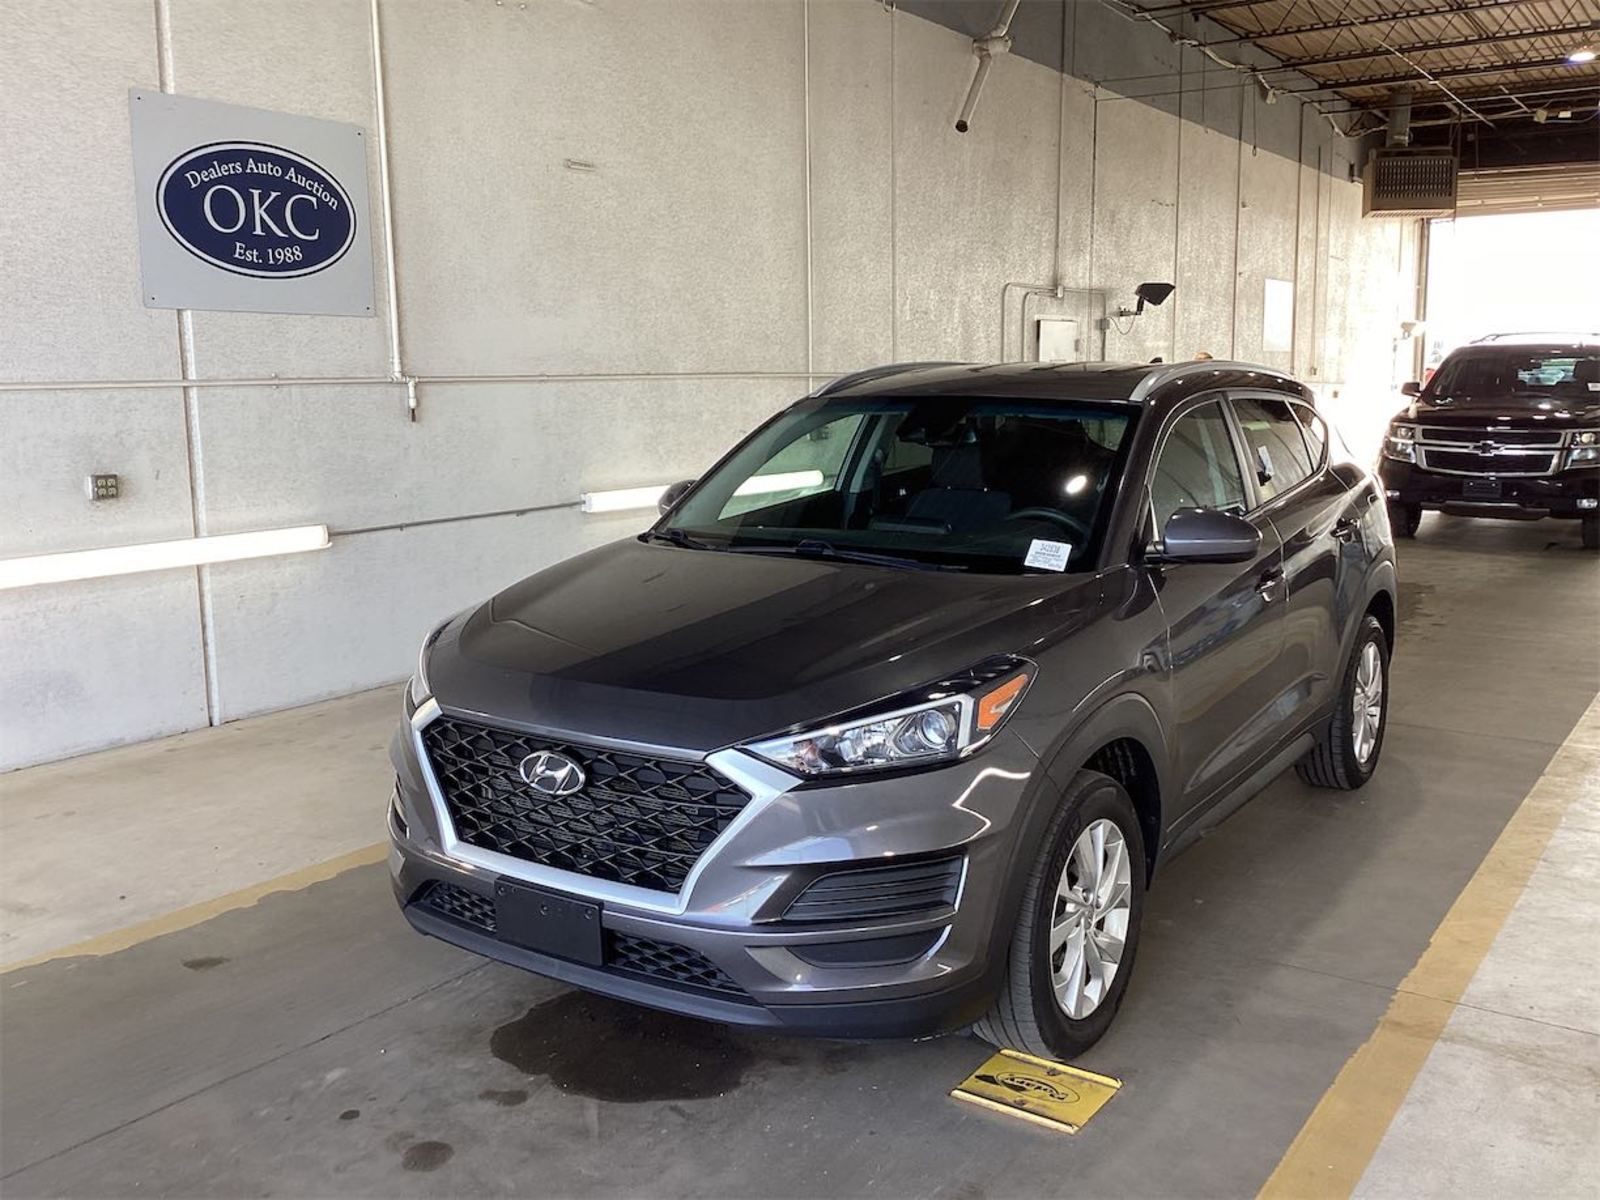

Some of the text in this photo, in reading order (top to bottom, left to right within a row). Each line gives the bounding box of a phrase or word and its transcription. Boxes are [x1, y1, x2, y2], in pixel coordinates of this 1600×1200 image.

[184, 158, 339, 210] Dealers Auto Auction
[203, 184, 320, 241] OKC
[233, 242, 303, 265] Est. 1988
